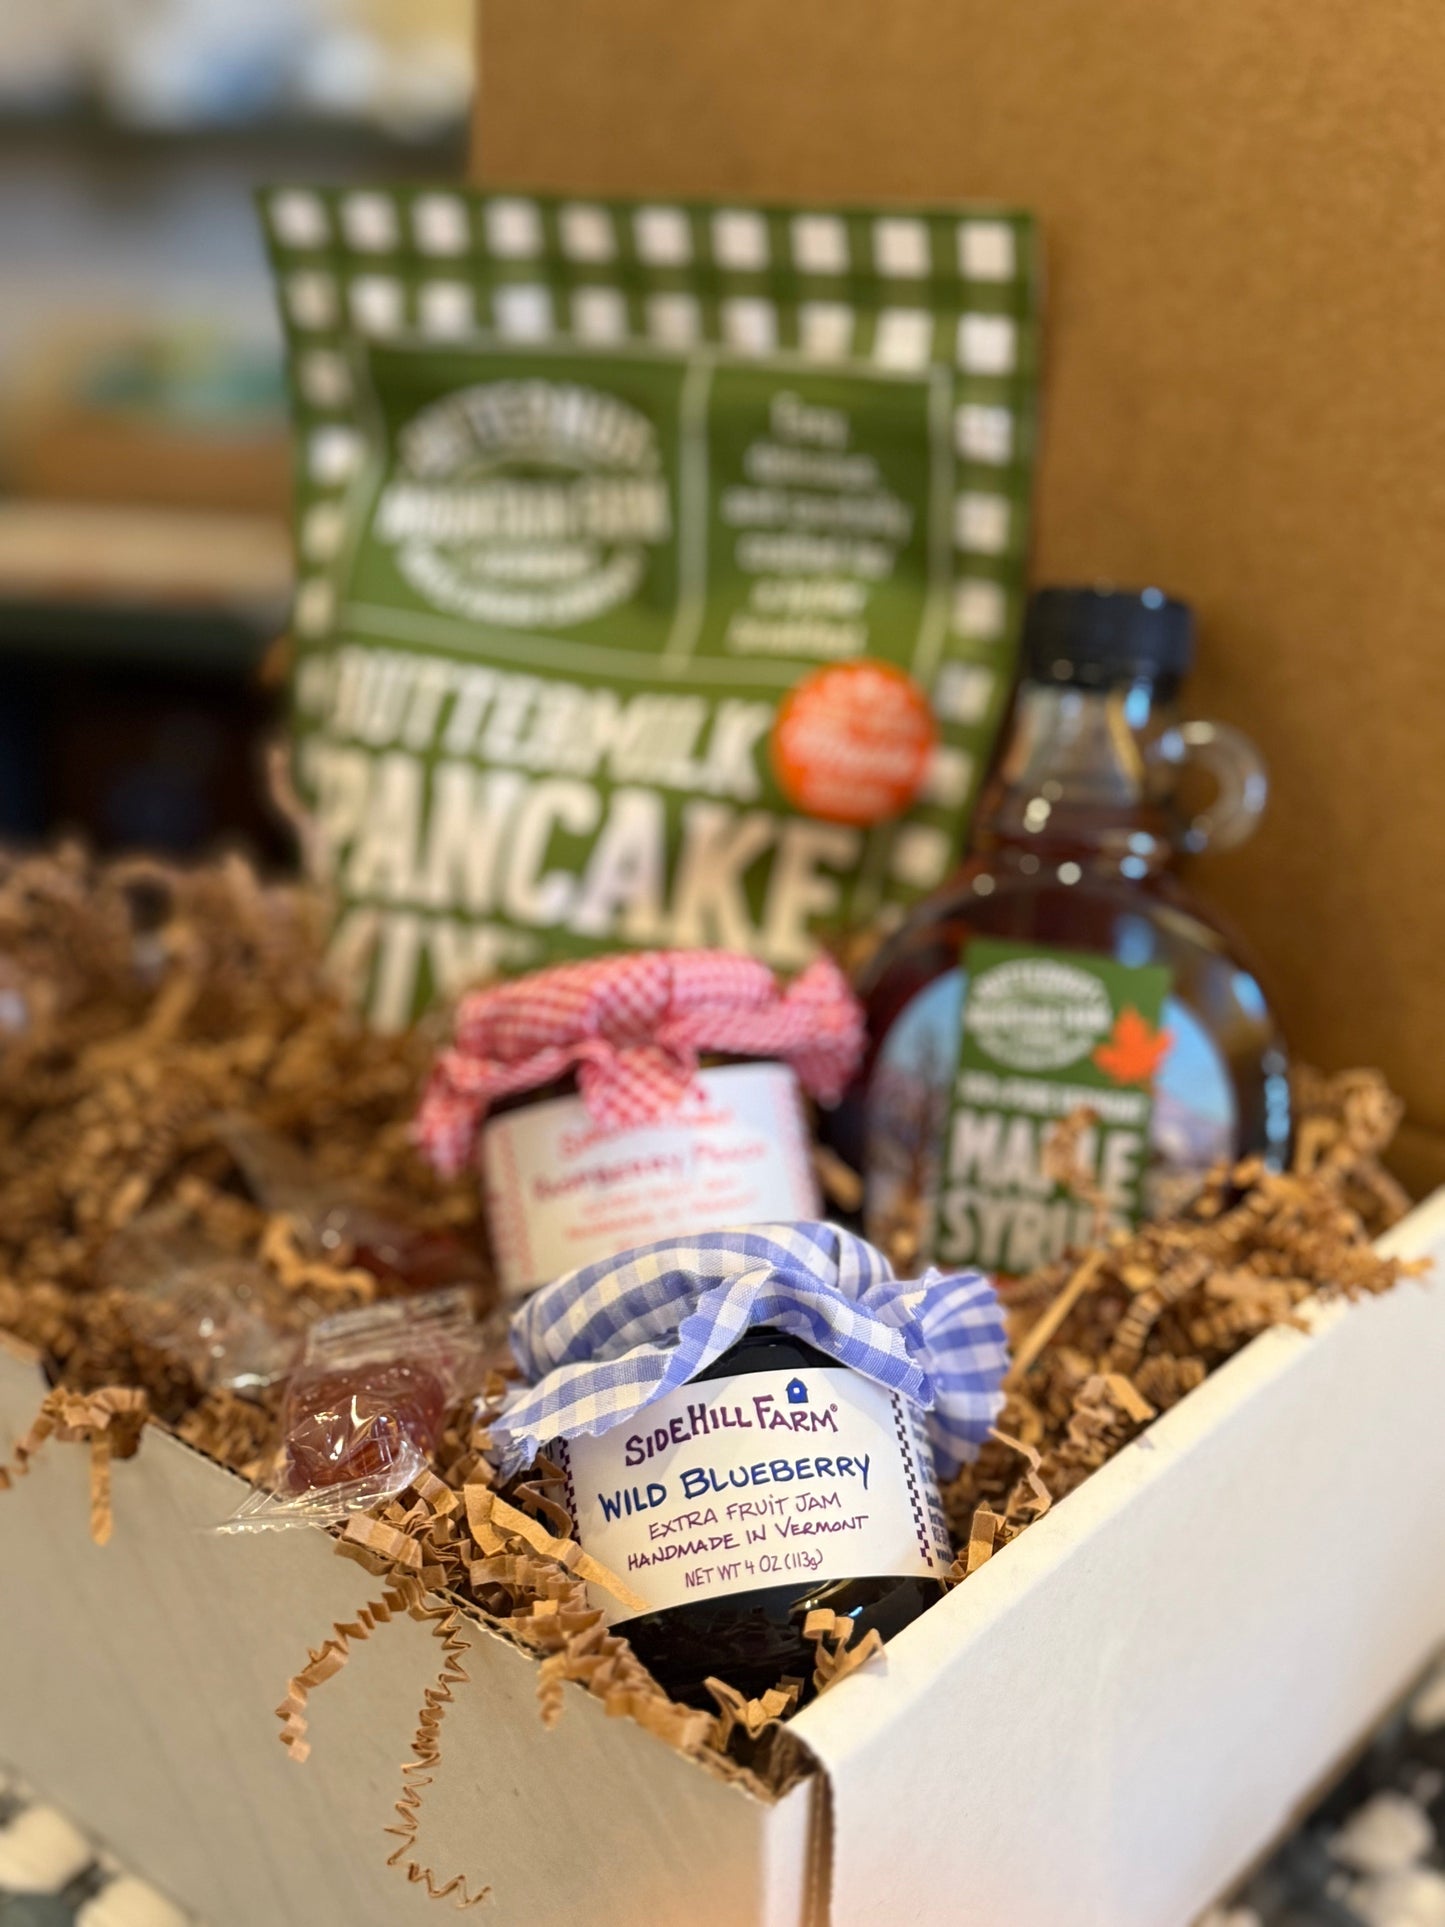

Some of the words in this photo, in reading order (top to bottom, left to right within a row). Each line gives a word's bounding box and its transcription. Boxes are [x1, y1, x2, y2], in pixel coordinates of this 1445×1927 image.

[306, 748, 860, 972] PANCAKE
[951, 1104, 1142, 1212] MALE
[936, 1188, 1132, 1276] SYRU
[598, 1483, 667, 1522] WILD
[680, 1454, 870, 1500] BLUEBERRY
[649, 1508, 718, 1541] EXTRA
[795, 1492, 842, 1513] JAM
[627, 1533, 741, 1571] HANDMADE
[746, 1523, 767, 1545] IN
[774, 1514, 870, 1539] VERMONT
[684, 1566, 714, 1589] NET
[717, 1560, 743, 1582] WT
[745, 1557, 755, 1574] 4
[758, 1554, 783, 1573] OZ
